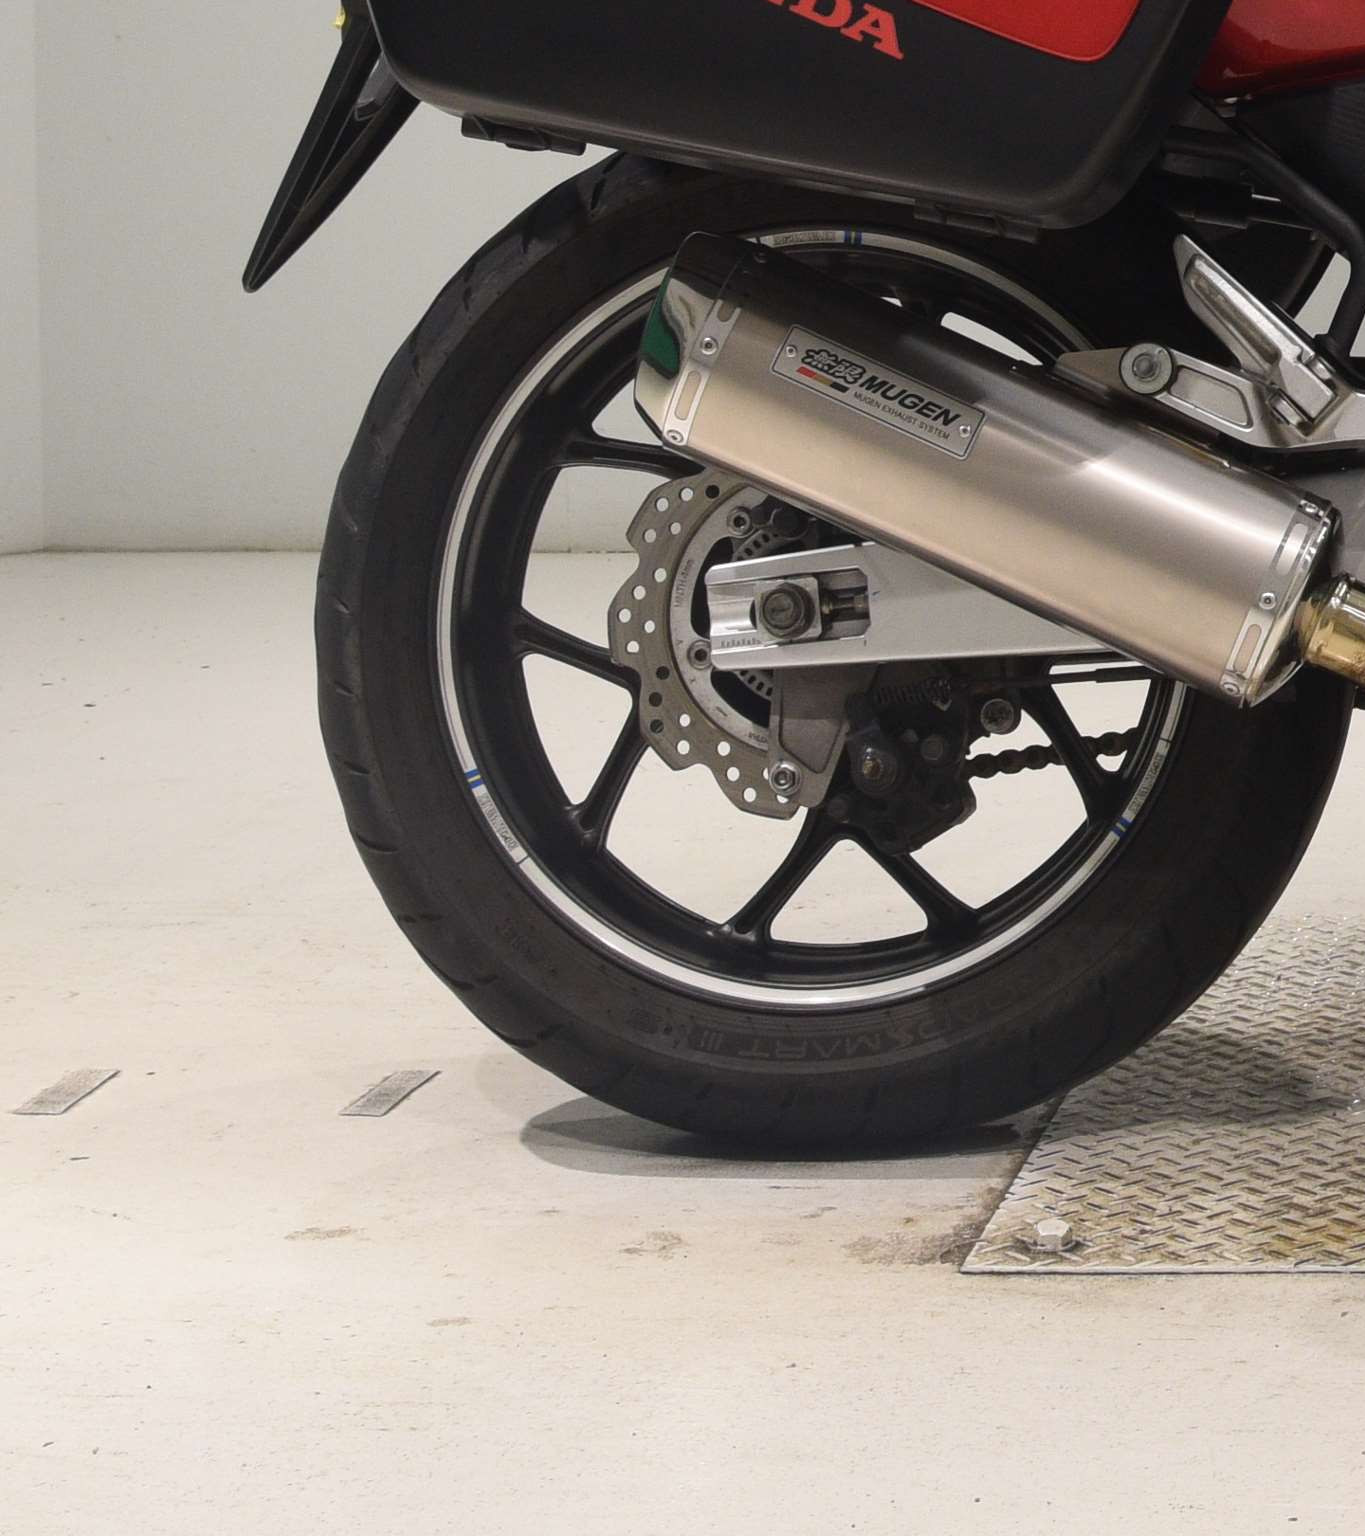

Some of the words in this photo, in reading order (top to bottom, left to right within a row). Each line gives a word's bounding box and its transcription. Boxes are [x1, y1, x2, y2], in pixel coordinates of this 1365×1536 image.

[854, 391, 882, 409] MUGEN
[882, 404, 918, 425] EXHAUST
[859, 375, 961, 426] MUGEN
